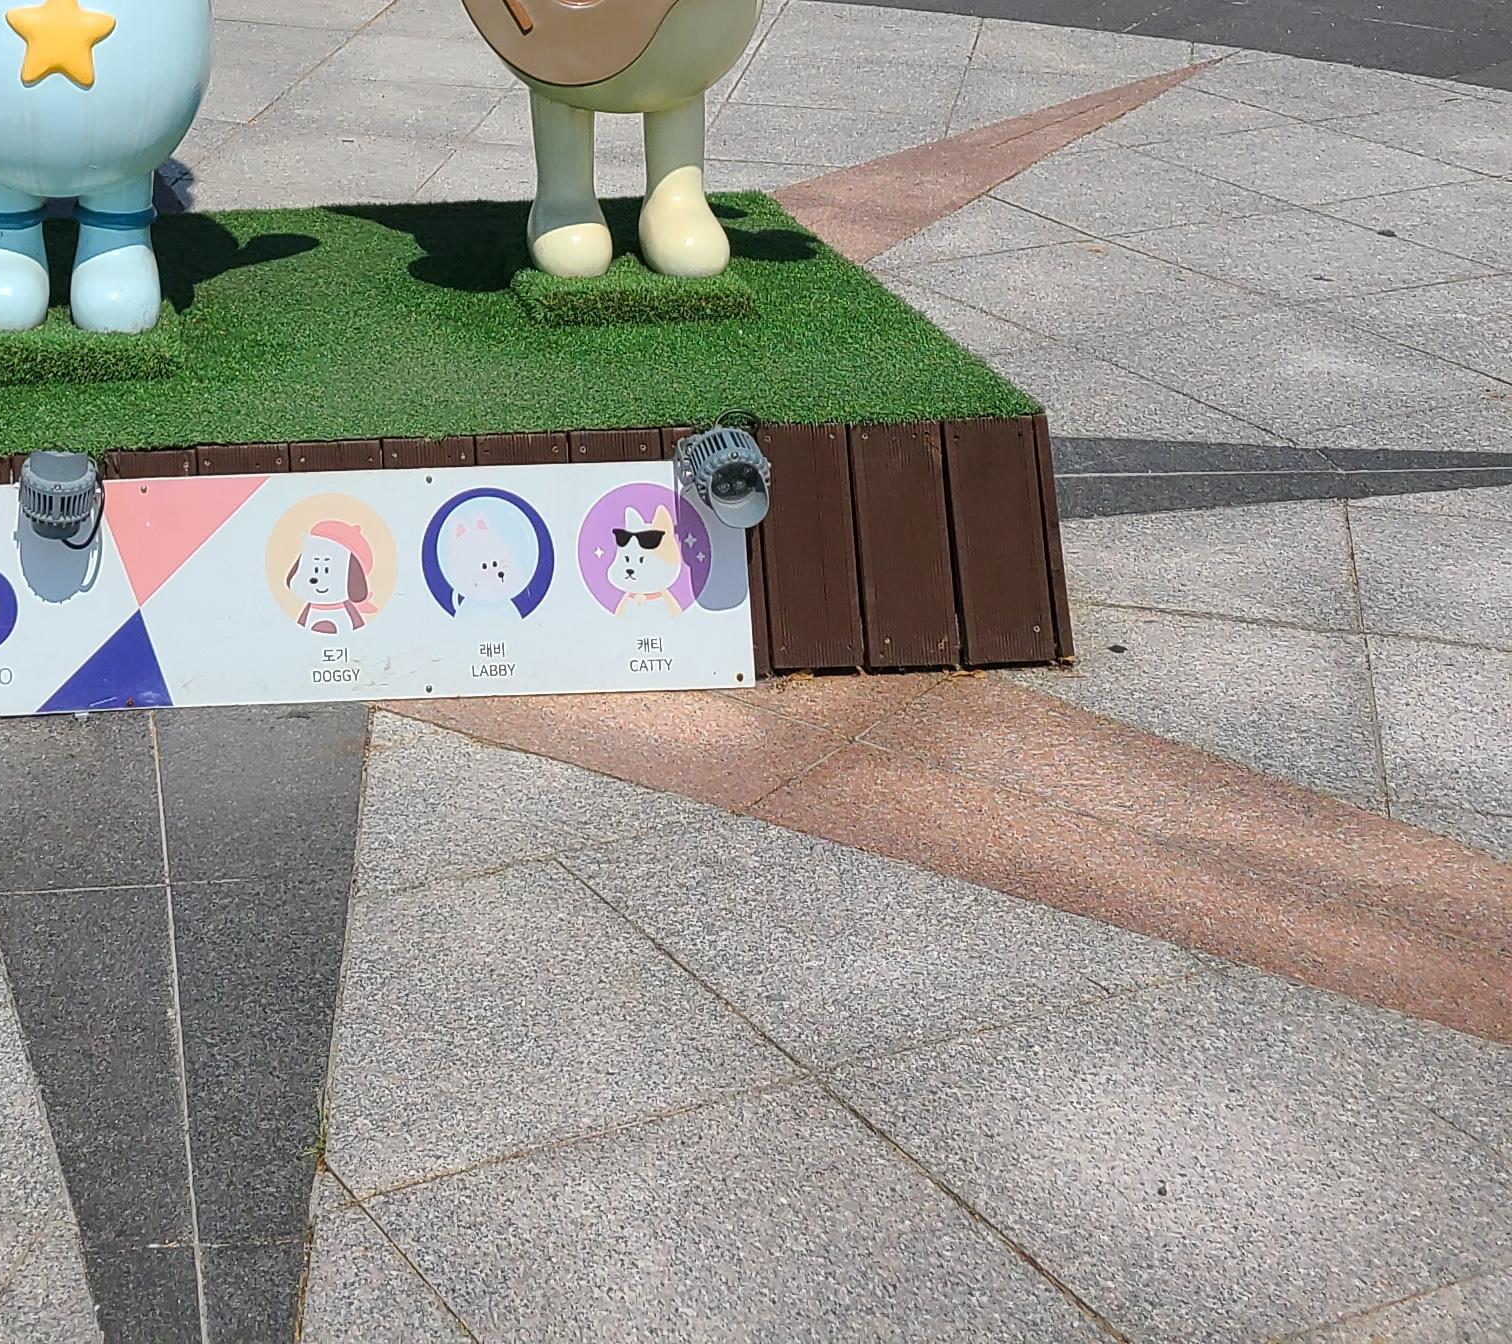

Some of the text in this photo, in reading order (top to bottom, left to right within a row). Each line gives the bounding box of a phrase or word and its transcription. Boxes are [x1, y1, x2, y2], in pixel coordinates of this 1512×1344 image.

[479, 642, 506, 658] 래비
[636, 637, 663, 653] 캐티
[322, 647, 349, 664] 도기
[471, 663, 516, 678] LABBY
[629, 658, 673, 673] CATTY
[312, 668, 361, 684] DOGGY
